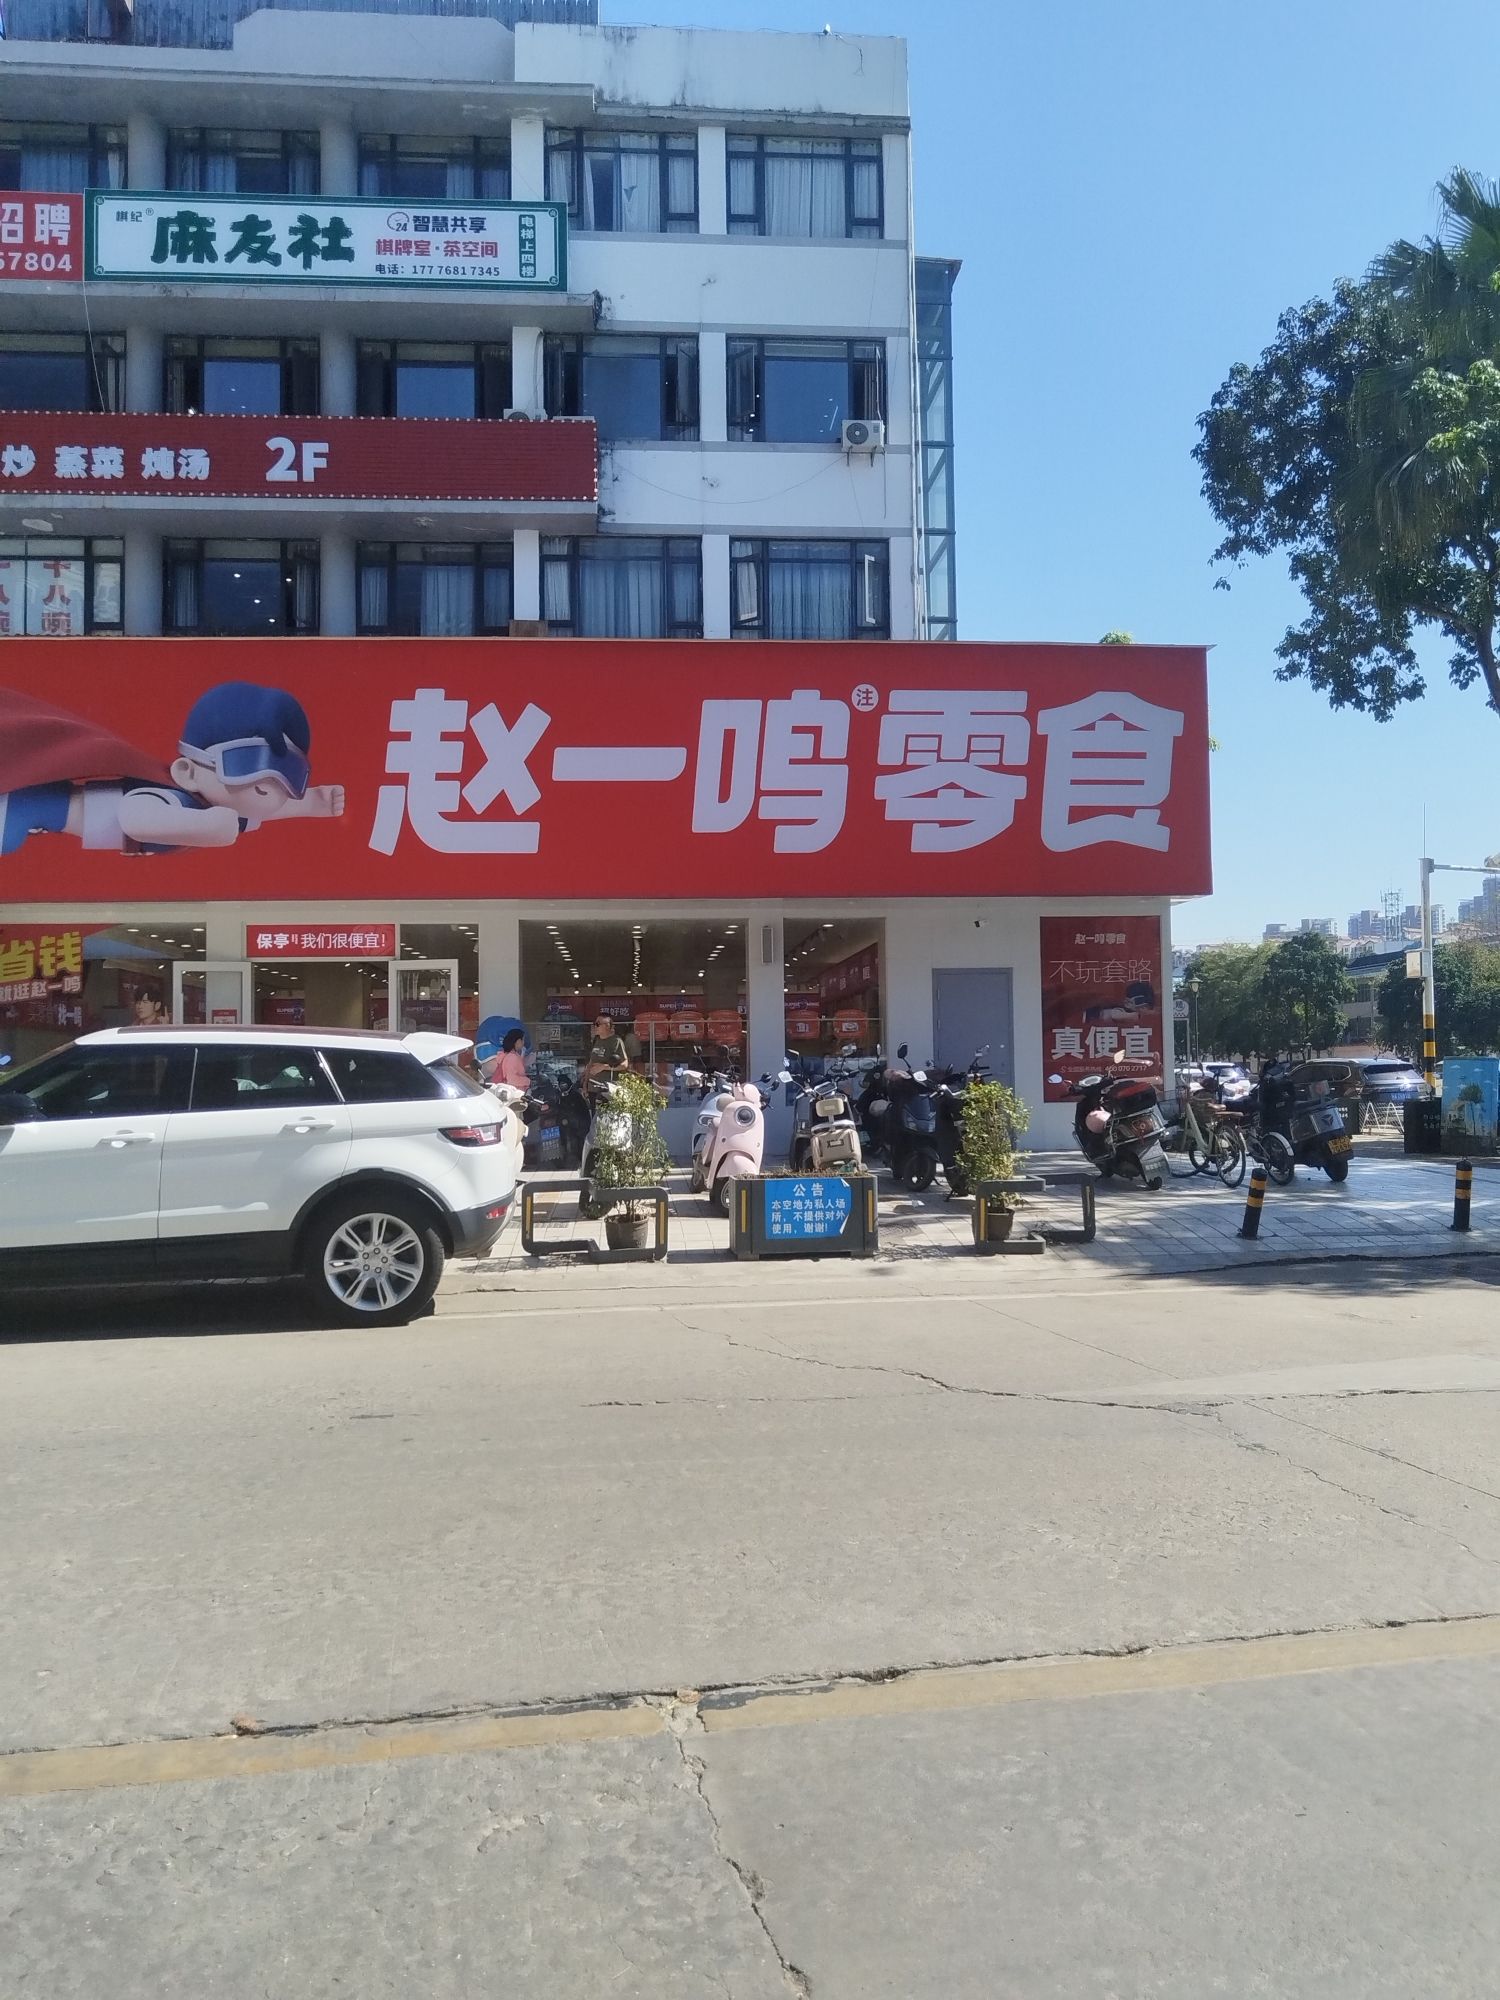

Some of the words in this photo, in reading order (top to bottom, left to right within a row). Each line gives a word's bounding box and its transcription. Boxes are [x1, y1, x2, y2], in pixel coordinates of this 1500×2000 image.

[0, 203, 71, 246] 招聘
[150, 210, 355, 271] 麻友社
[412, 215, 487, 233] 智慧共享
[521, 216, 535, 277] 电梯上四楼
[1, 445, 36, 478] 炒
[55, 445, 125, 479] 蒸菜
[141, 446, 210, 481] 炖汤
[265, 436, 329, 483] 2F
[368, 688, 1185, 856] 赵一鸣零食
[0, 932, 82, 982] 省钱
[1050, 958, 1152, 983] 不玩套路
[1051, 1025, 1154, 1059] 真便宜
[772, 1199, 846, 1210] 本空地为私人场
[793, 1183, 824, 1197] 公告
